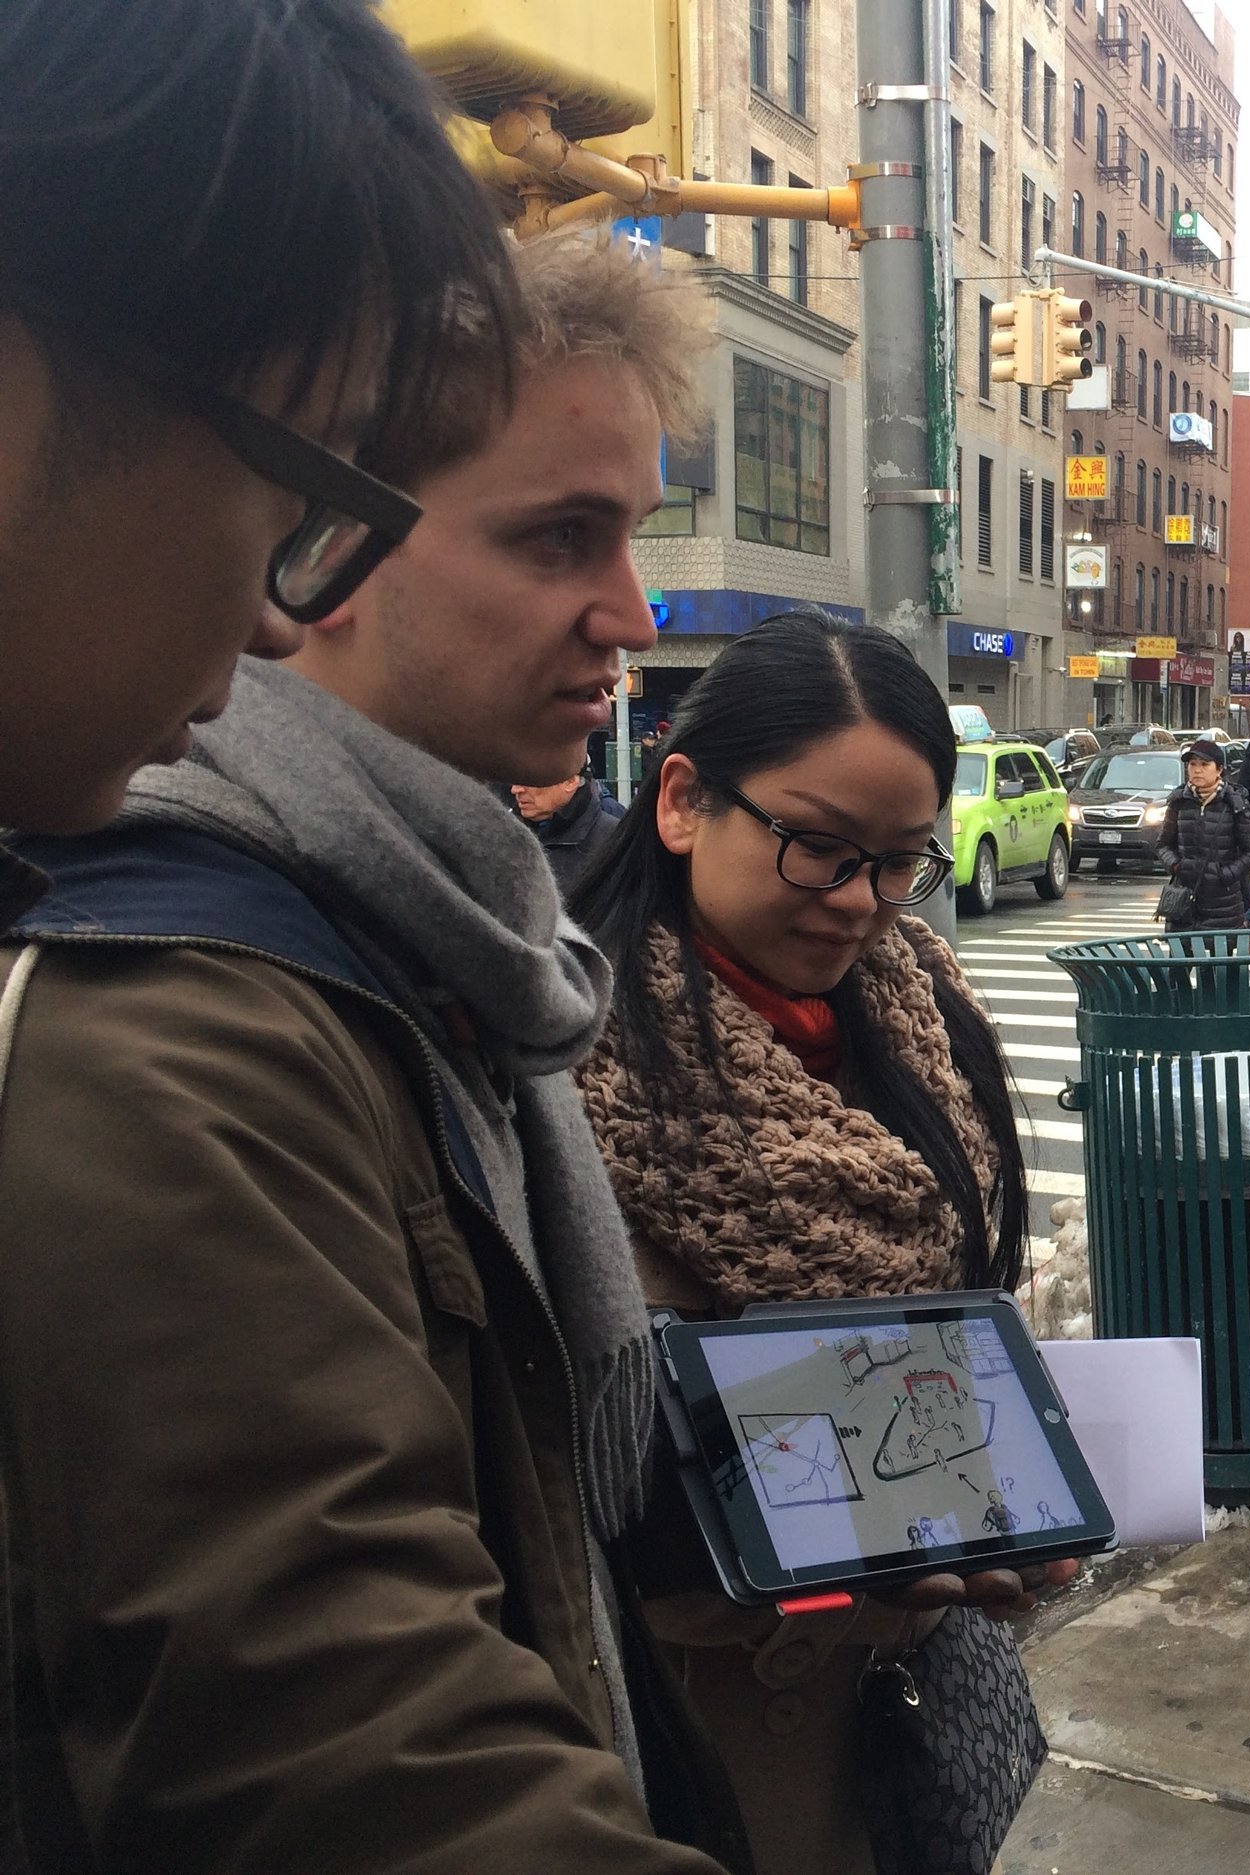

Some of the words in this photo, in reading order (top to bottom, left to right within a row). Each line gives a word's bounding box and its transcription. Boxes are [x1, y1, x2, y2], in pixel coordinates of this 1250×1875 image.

[1069, 483, 1086, 497] KAM
[1087, 483, 1106, 497] HING
[973, 632, 1003, 653] CHASE
